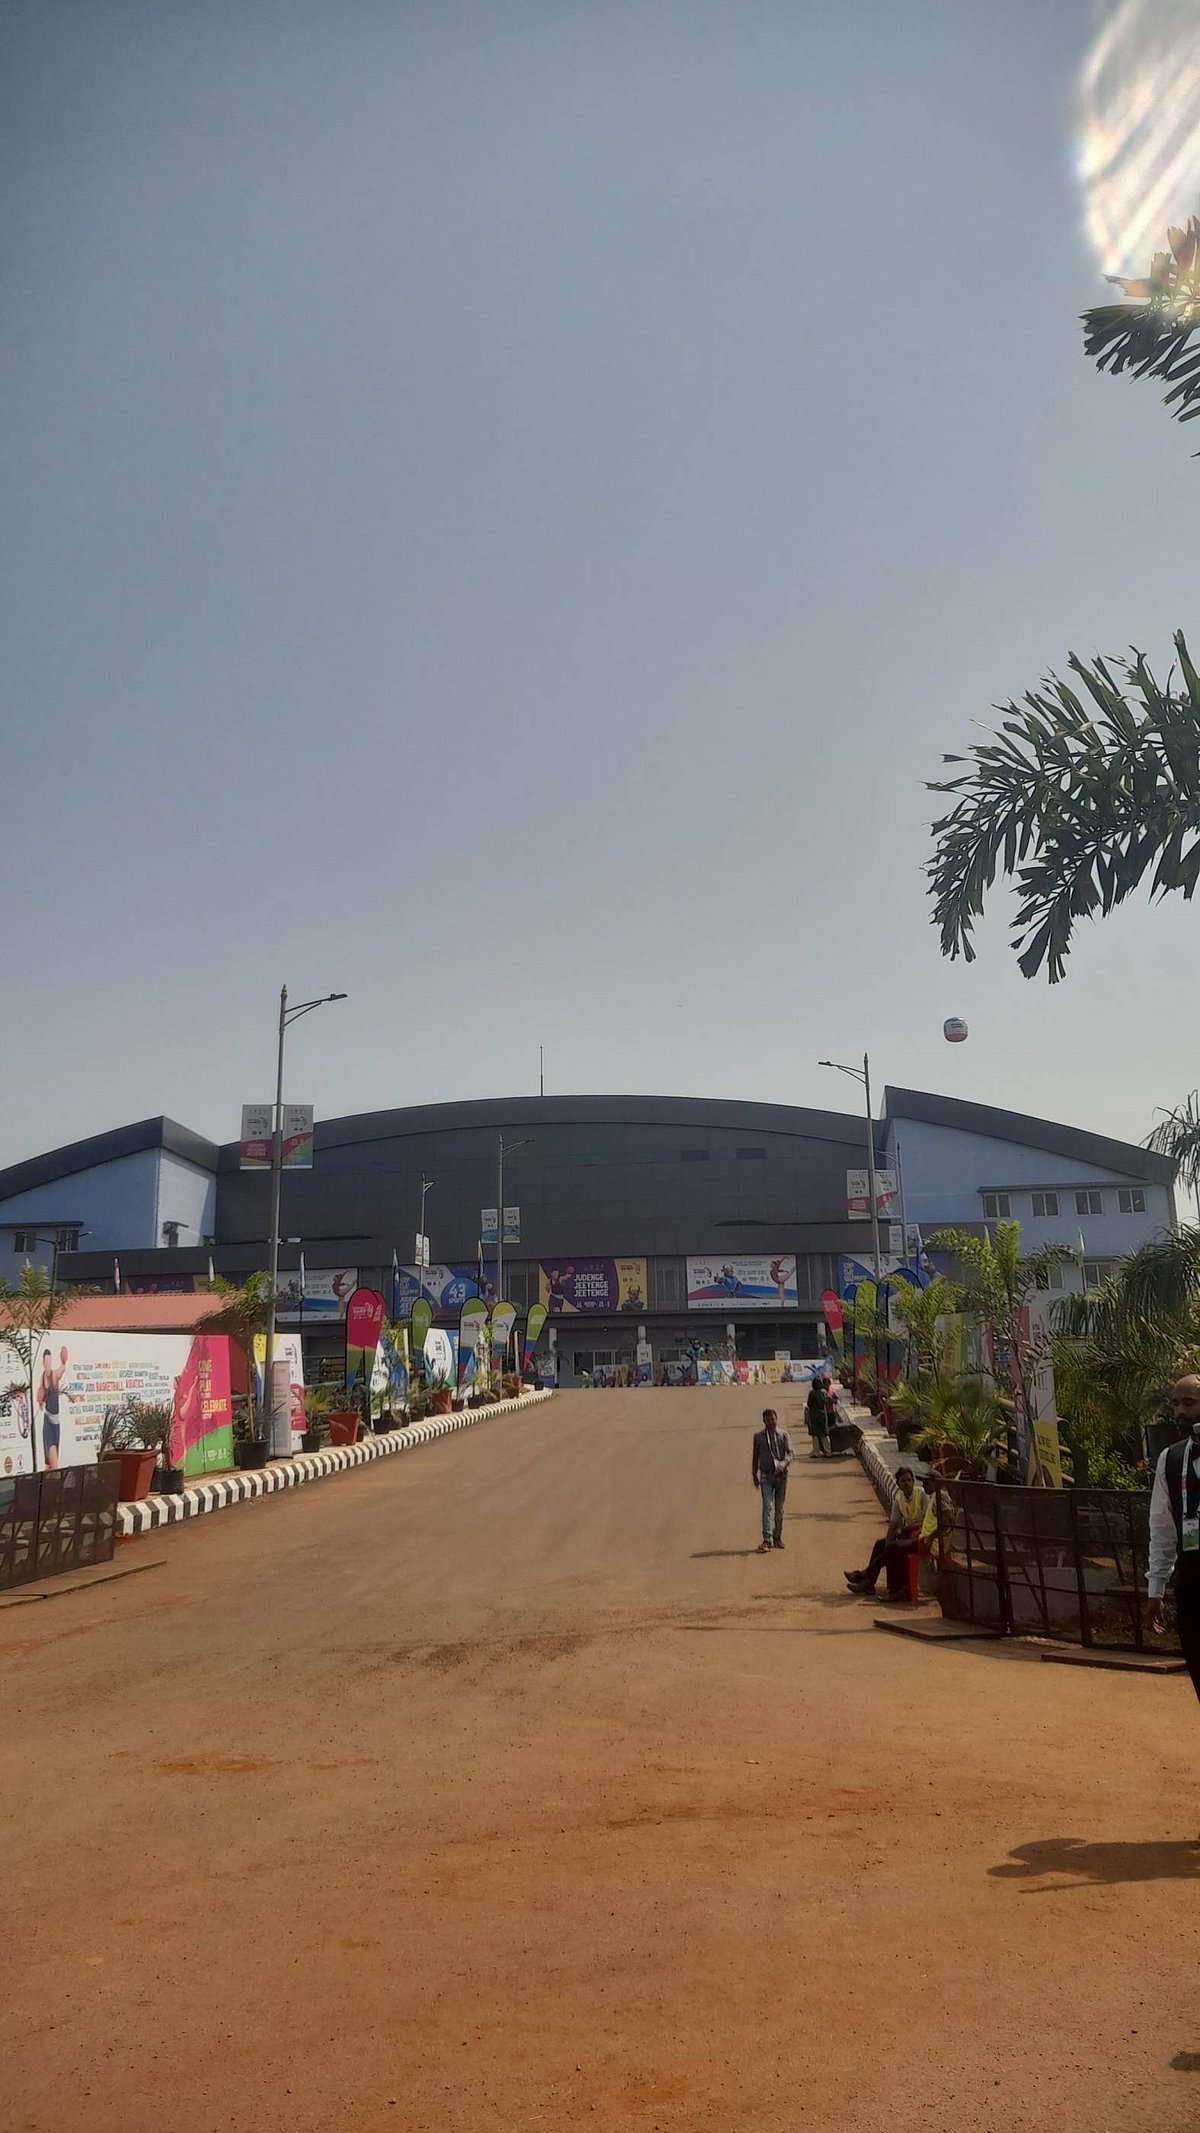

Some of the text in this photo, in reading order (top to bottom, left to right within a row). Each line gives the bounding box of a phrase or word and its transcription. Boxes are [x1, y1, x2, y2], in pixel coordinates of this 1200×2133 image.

[574, 1273, 604, 1281] JUDENGE
[574, 1281, 609, 1289] JEEYENGE
[449, 1283, 466, 1298] 43
[574, 1289, 609, 1297] JEETENGE
[201, 1398, 227, 1413] CELEBRATE
